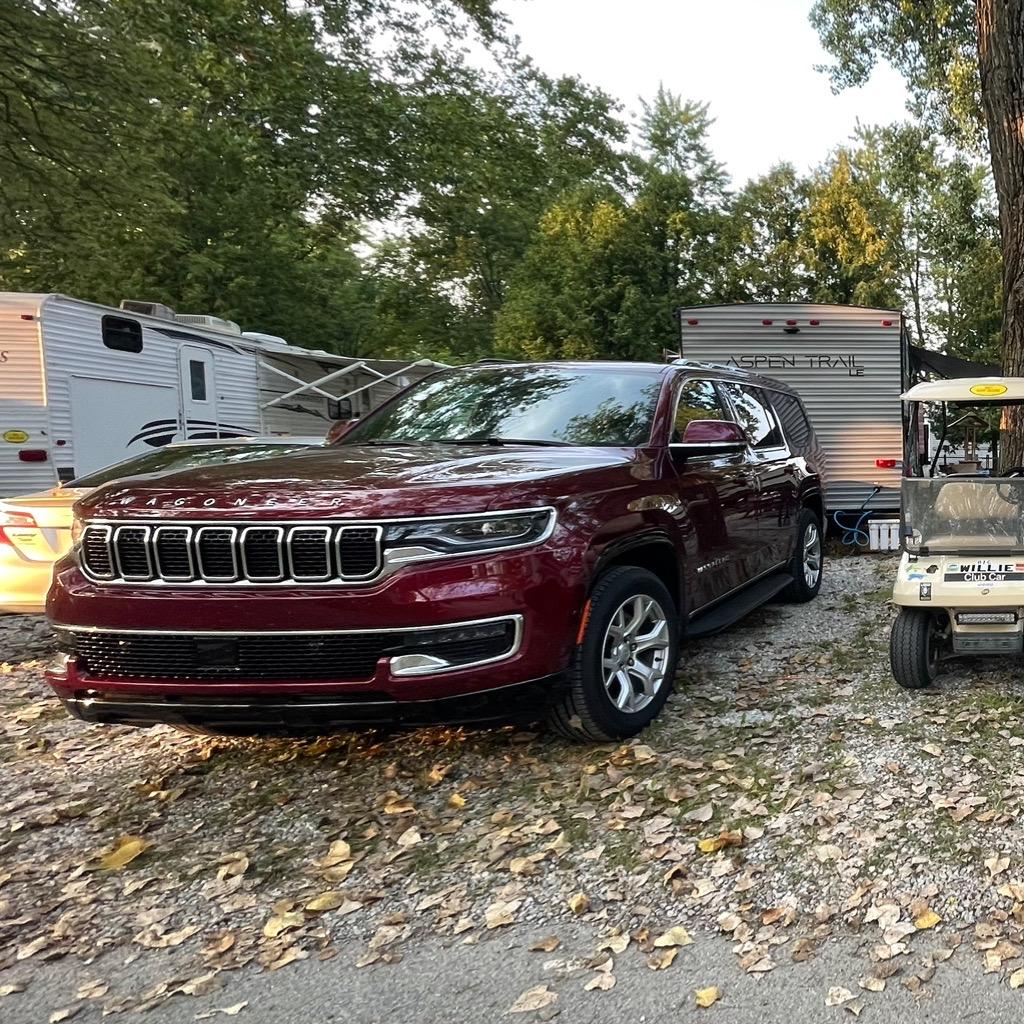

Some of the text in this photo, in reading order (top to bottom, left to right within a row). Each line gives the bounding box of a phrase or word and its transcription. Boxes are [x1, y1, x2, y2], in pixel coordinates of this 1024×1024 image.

[726, 355, 864, 369] ASPEN TRAIL
[849, 369, 865, 377] LE
[120, 497, 344, 506] WAGONEER
[960, 564, 1014, 572] WILLIE
[964, 571, 1006, 581] Club Car
